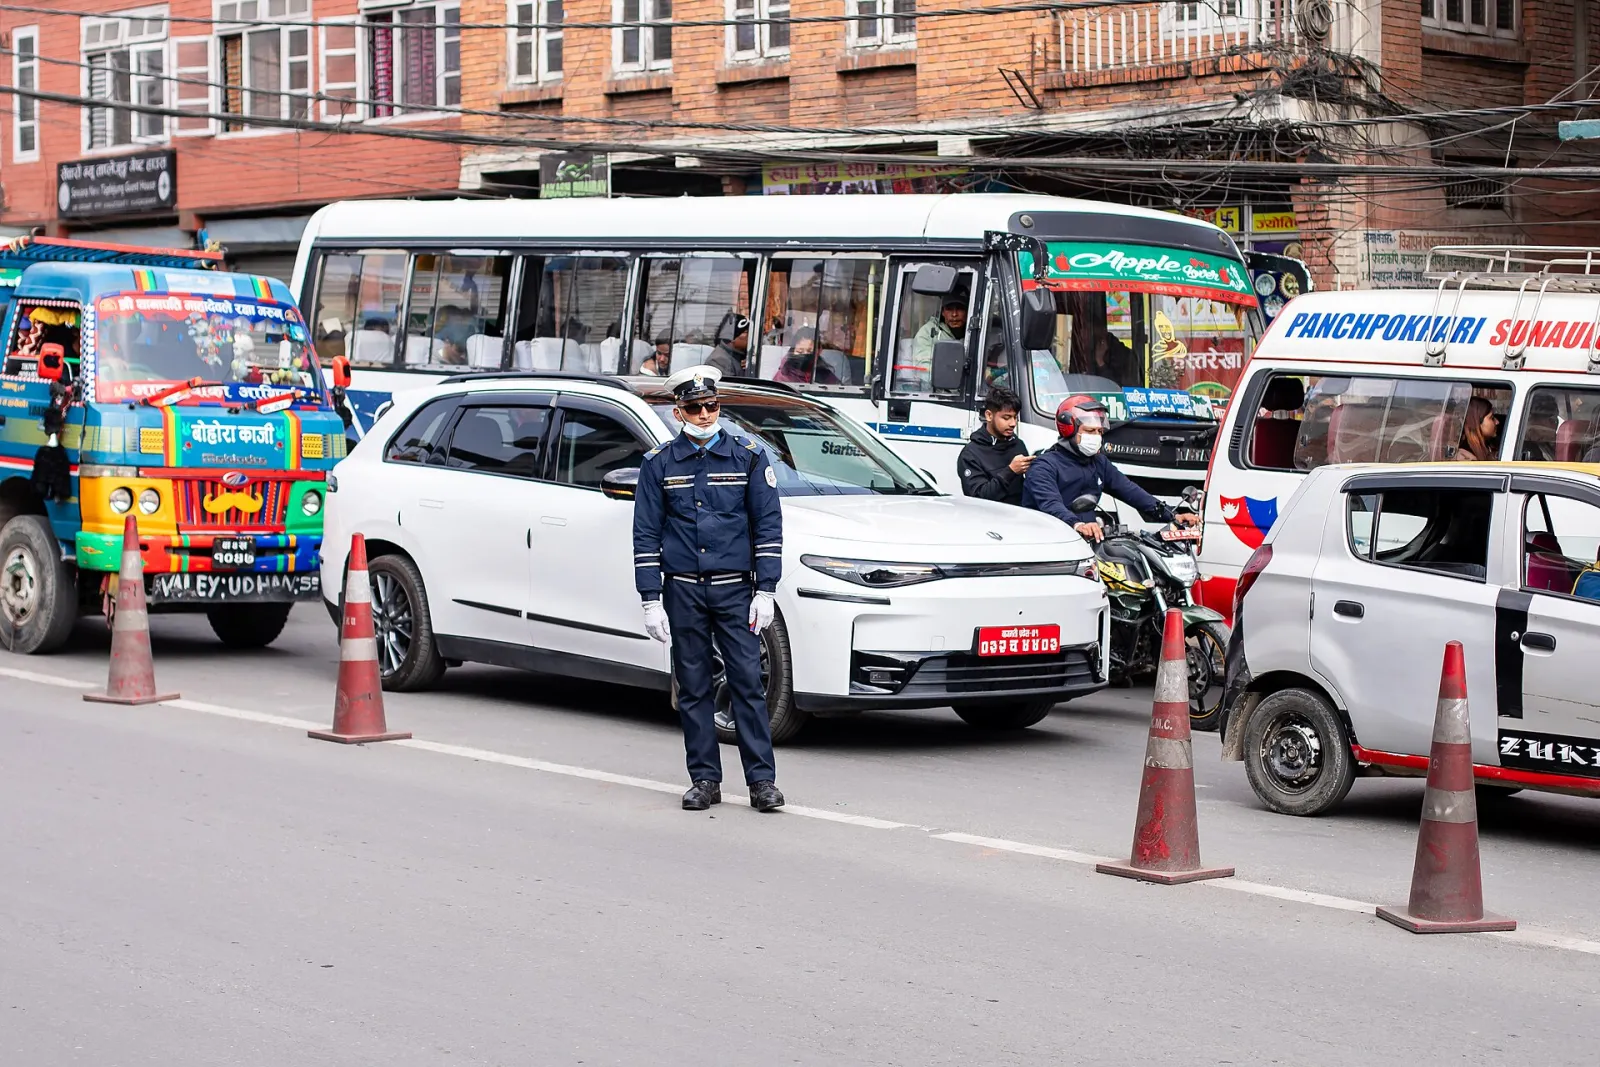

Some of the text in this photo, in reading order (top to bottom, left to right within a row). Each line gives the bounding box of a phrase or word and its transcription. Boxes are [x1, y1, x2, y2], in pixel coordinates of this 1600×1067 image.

[1256, 215, 1298, 230] ज्योति
[1069, 249, 1182, 274] Apple
[1285, 312, 1600, 351] PANCHPOKHARI SUNAUL
[191, 419, 275, 445] बोहोरा काजी
